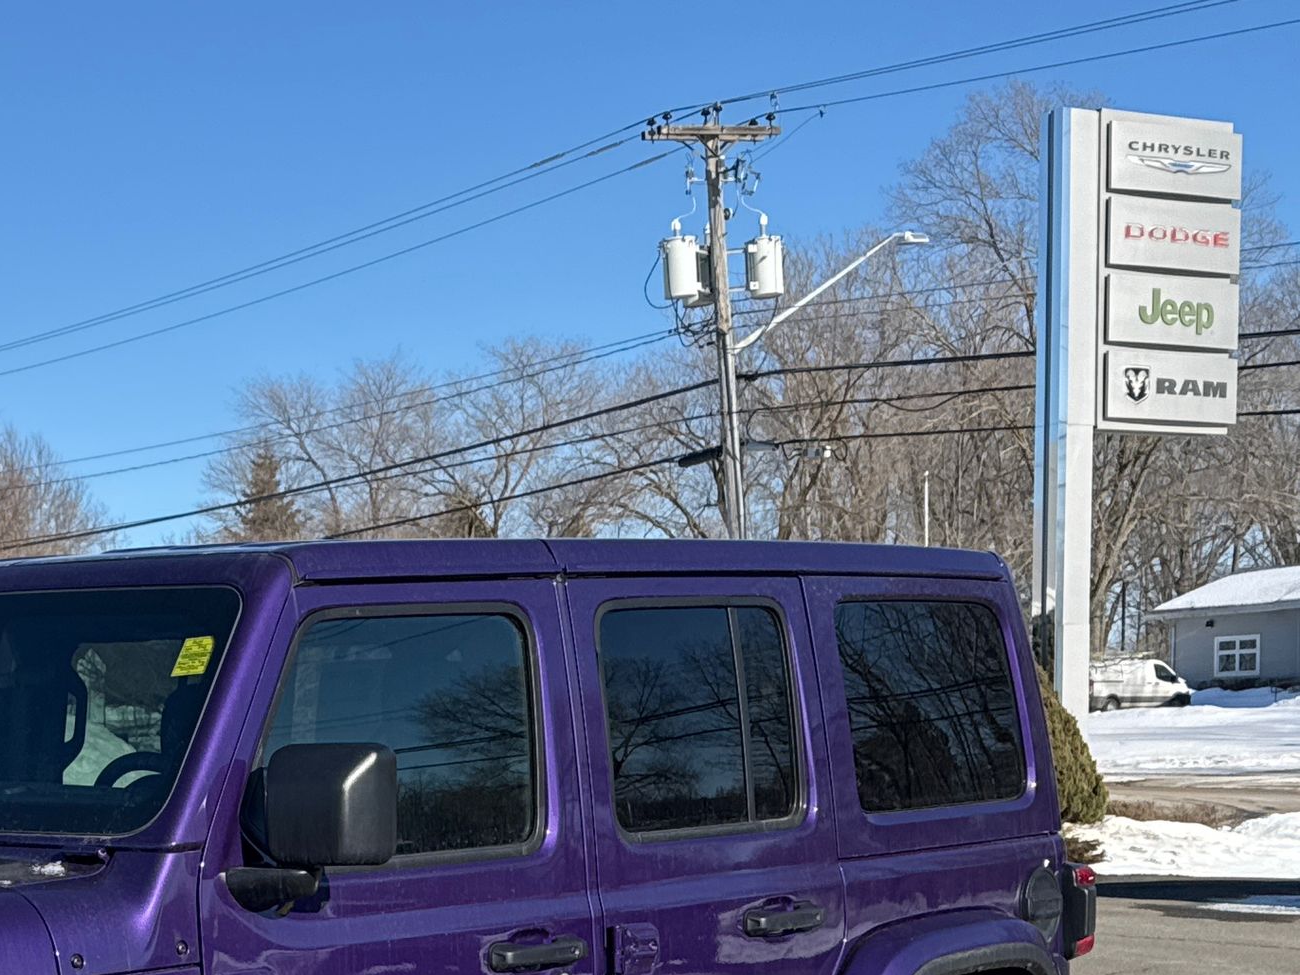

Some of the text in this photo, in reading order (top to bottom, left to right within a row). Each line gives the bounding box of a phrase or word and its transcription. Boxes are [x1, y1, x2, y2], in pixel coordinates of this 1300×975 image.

[1128, 141, 1231, 160] CHRYSLER
[1124, 223, 1230, 248] DODGE
[1139, 288, 1214, 335] Jeep
[1156, 377, 1228, 398] RAM
